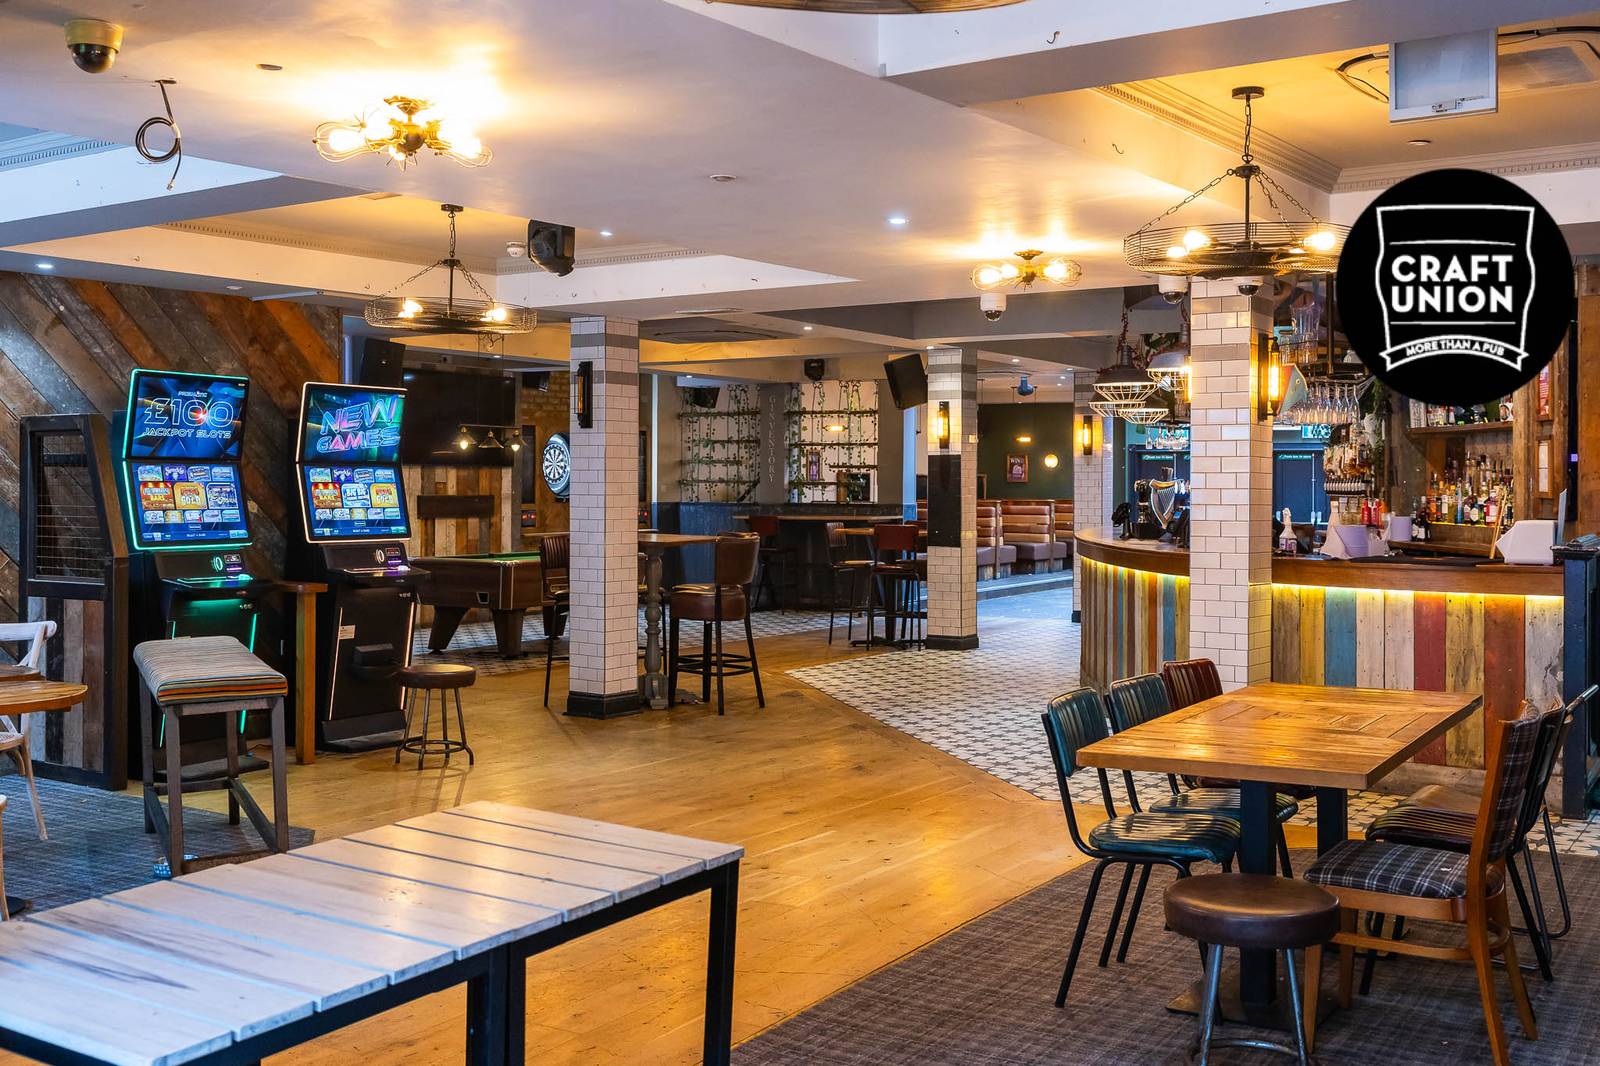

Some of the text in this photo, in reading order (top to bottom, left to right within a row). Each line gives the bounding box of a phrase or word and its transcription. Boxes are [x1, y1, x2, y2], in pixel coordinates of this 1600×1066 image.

[144, 398, 234, 428] £100
[320, 394, 398, 435] NEW
[143, 427, 232, 439] JACKPOT SLOTS
[317, 426, 401, 454] GAMES
